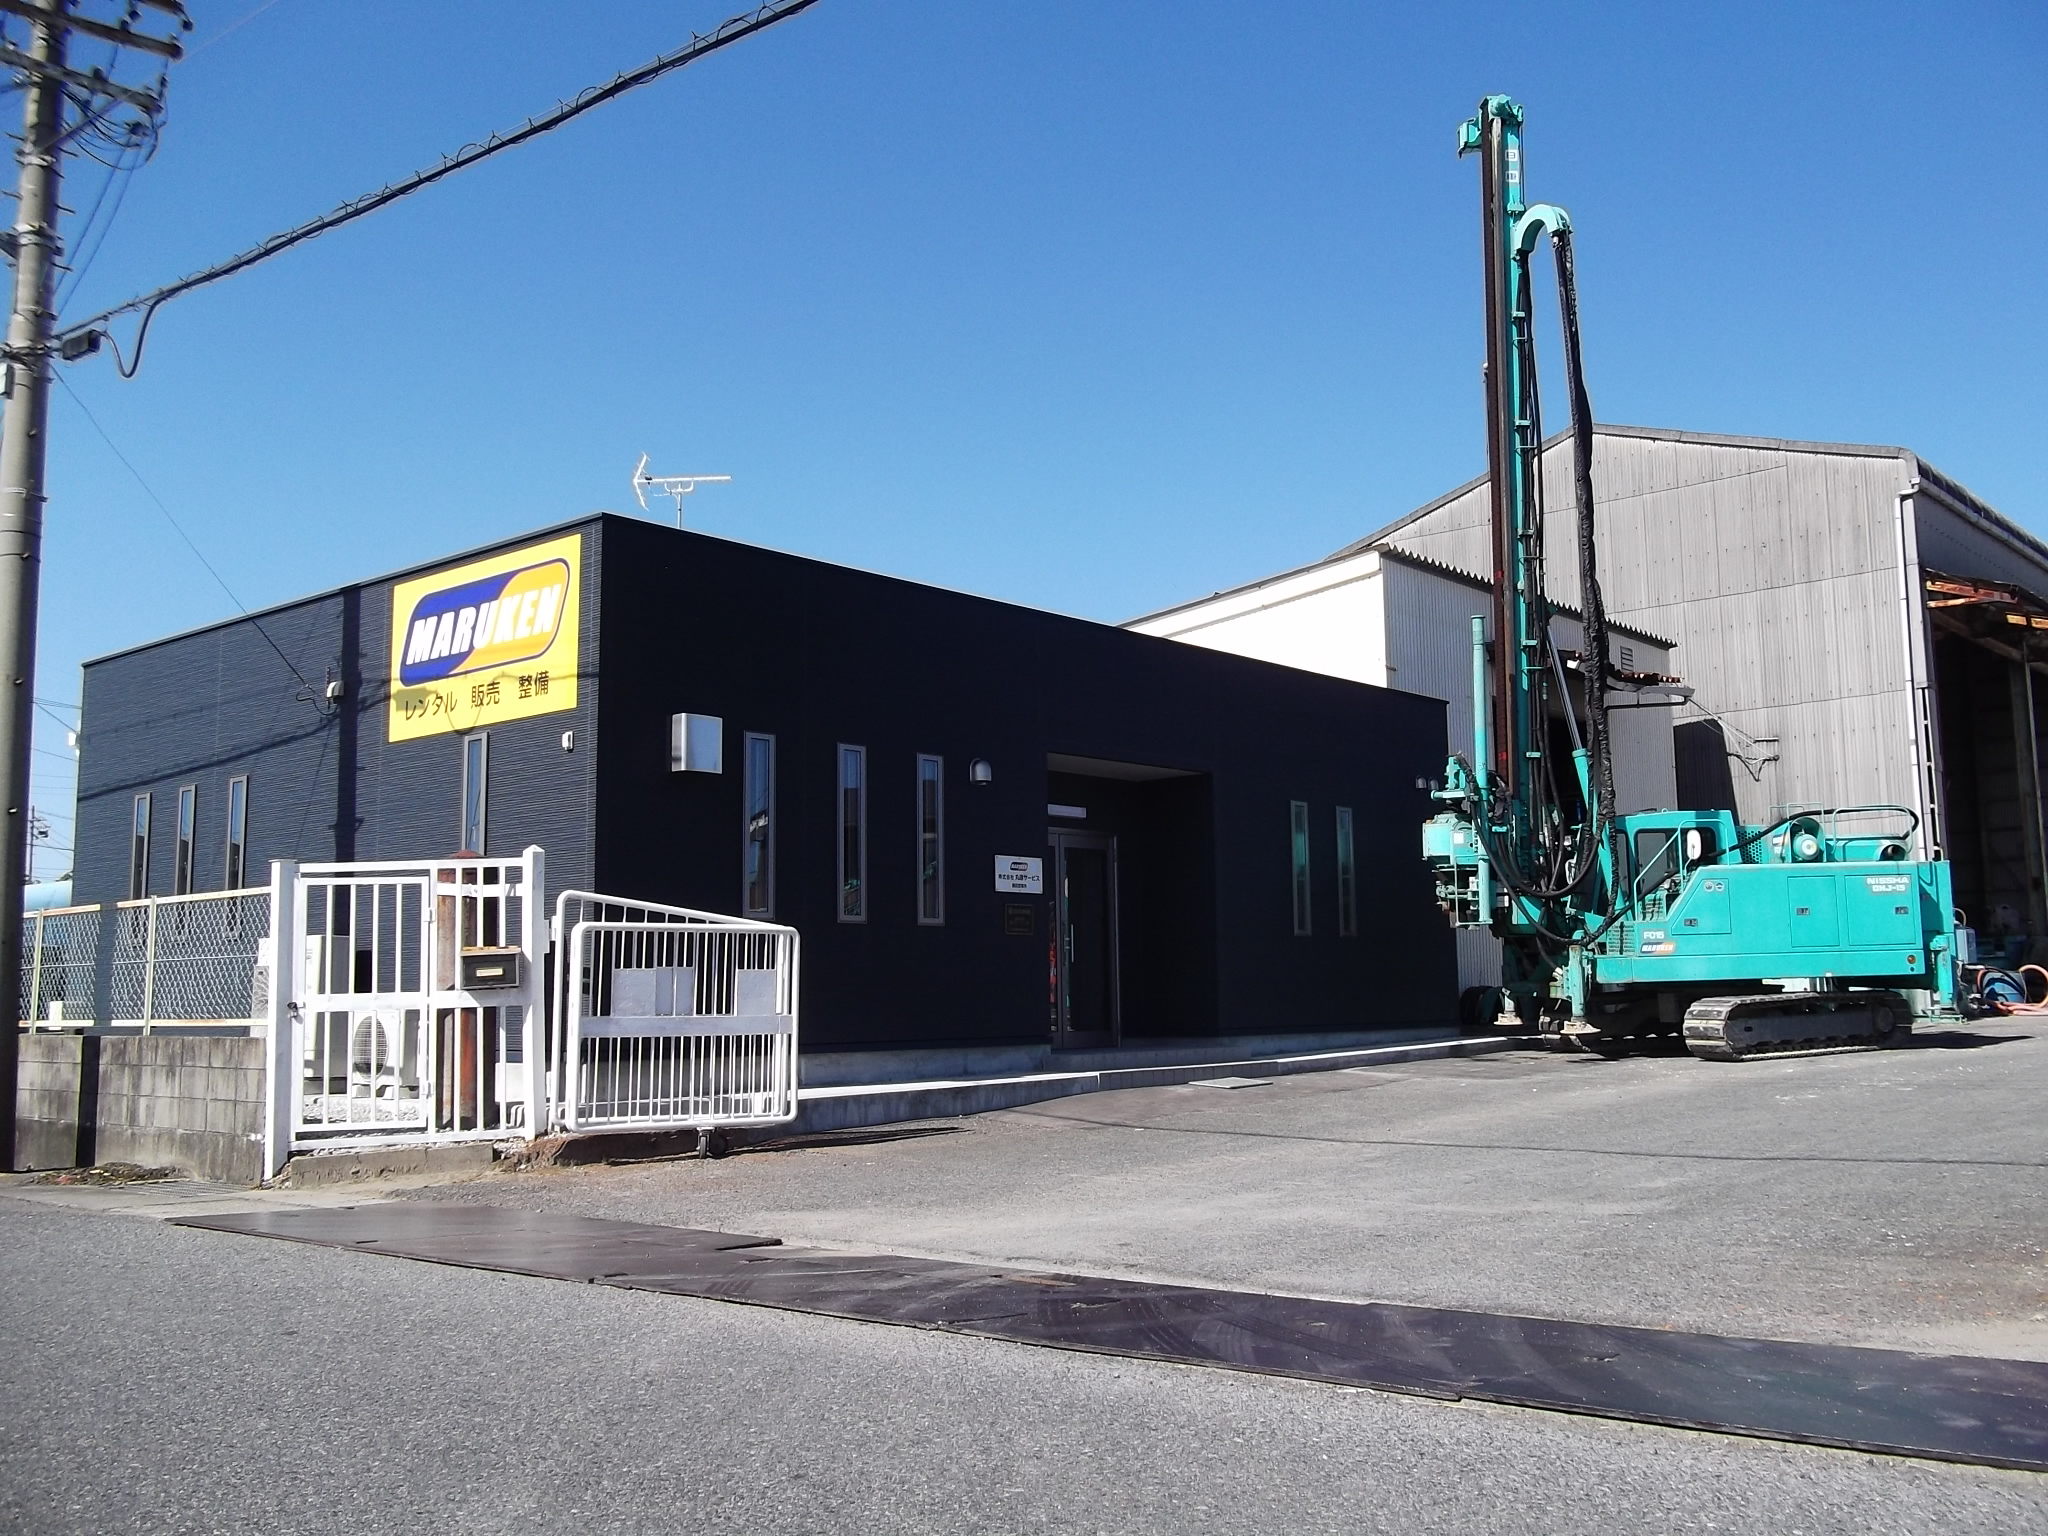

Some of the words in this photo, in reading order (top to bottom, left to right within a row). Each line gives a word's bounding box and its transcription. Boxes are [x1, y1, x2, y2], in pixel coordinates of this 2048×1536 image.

[406, 583, 562, 666] MARUKEN
[405, 691, 457, 721] レンタル
[471, 681, 500, 709] 販売
[518, 670, 549, 699] 整備
[1866, 876, 1910, 885] NISSHA
